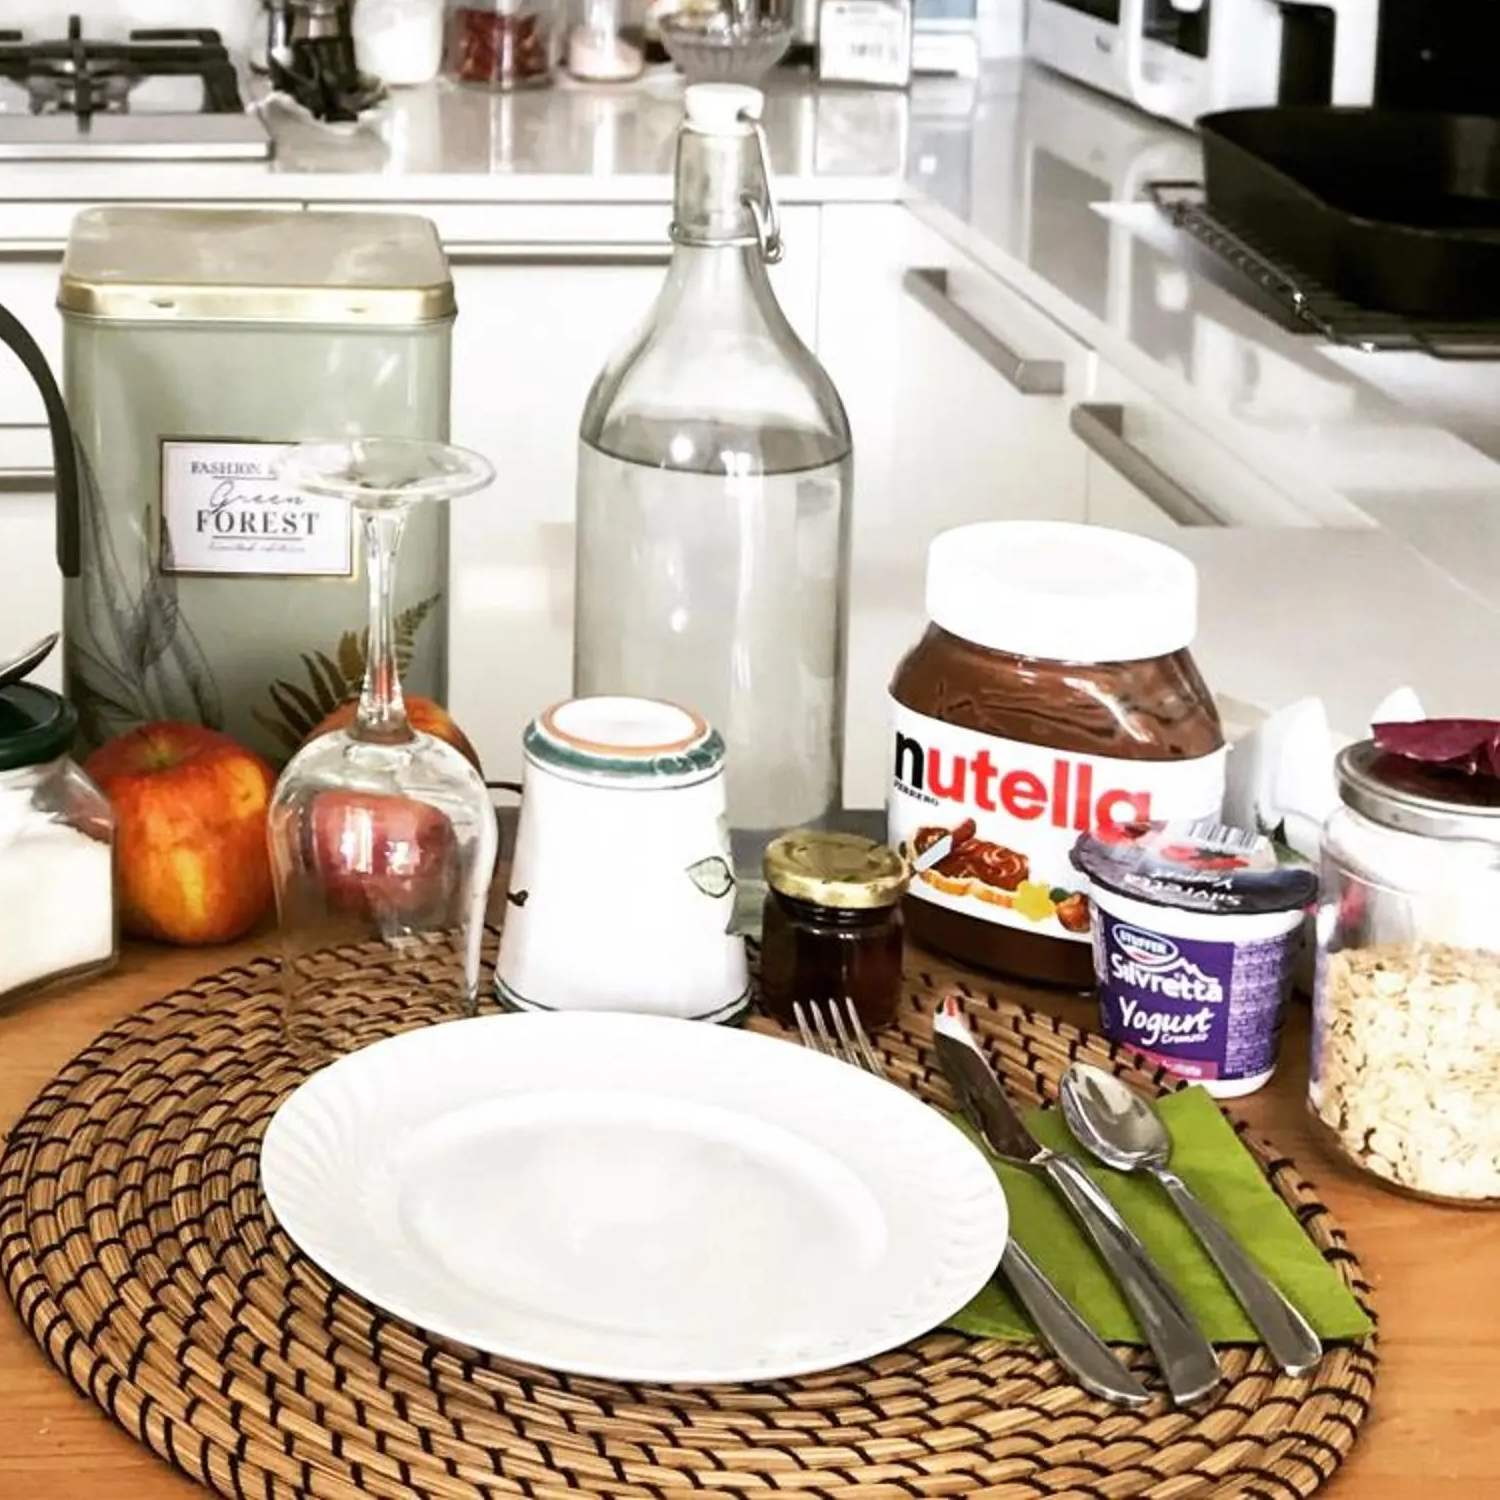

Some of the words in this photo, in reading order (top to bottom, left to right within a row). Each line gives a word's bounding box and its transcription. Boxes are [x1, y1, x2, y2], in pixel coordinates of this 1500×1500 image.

[191, 461, 262, 475] FASHION
[210, 479, 304, 514] Green
[196, 508, 320, 535] FOREST
[895, 731, 1153, 843] nutella
[1111, 953, 1223, 1003] Silvretta
[1119, 996, 1216, 1046] Yogurt
